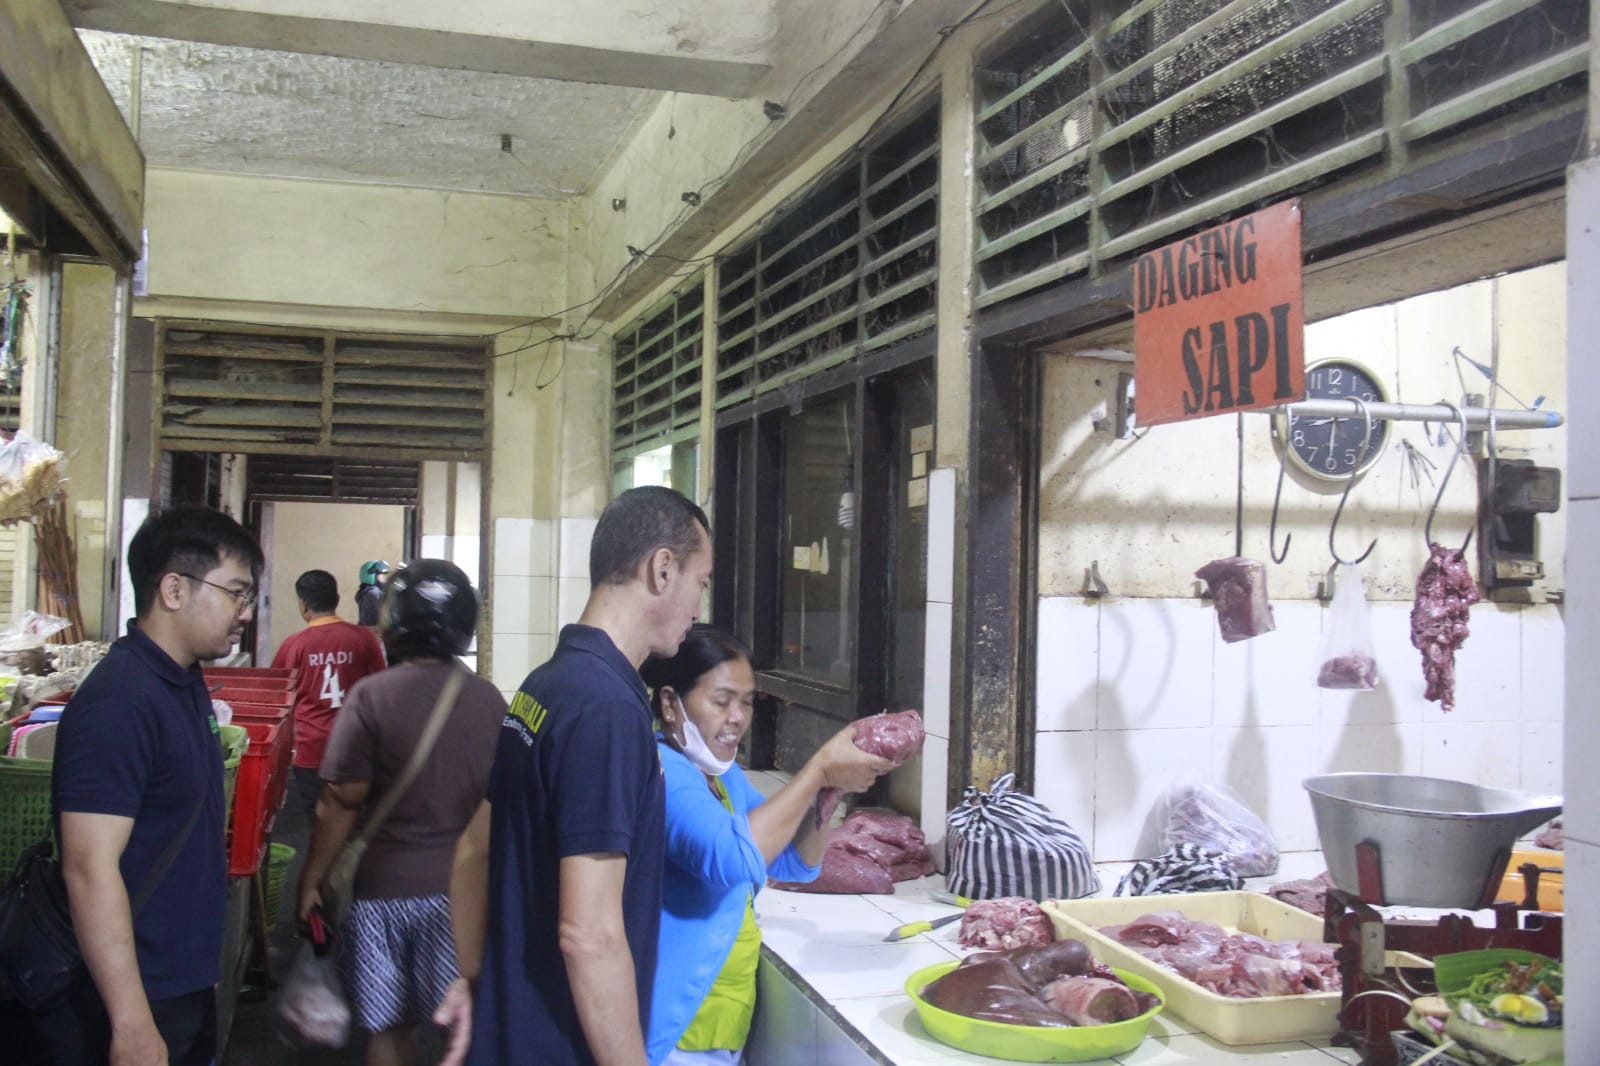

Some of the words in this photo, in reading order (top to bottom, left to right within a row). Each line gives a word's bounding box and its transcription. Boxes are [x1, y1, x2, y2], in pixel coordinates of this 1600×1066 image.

[1137, 217, 1257, 314] DAGING
[1182, 303, 1293, 415] SAPI
[1311, 373, 1322, 389] 11
[1328, 368, 1342, 385] 12
[1351, 376, 1357, 392] 1
[1294, 430, 1305, 447] 8
[1306, 446, 1319, 462] 7
[1344, 449, 1357, 465] 5
[308, 651, 353, 666] RIADI
[320, 663, 345, 709] 4
